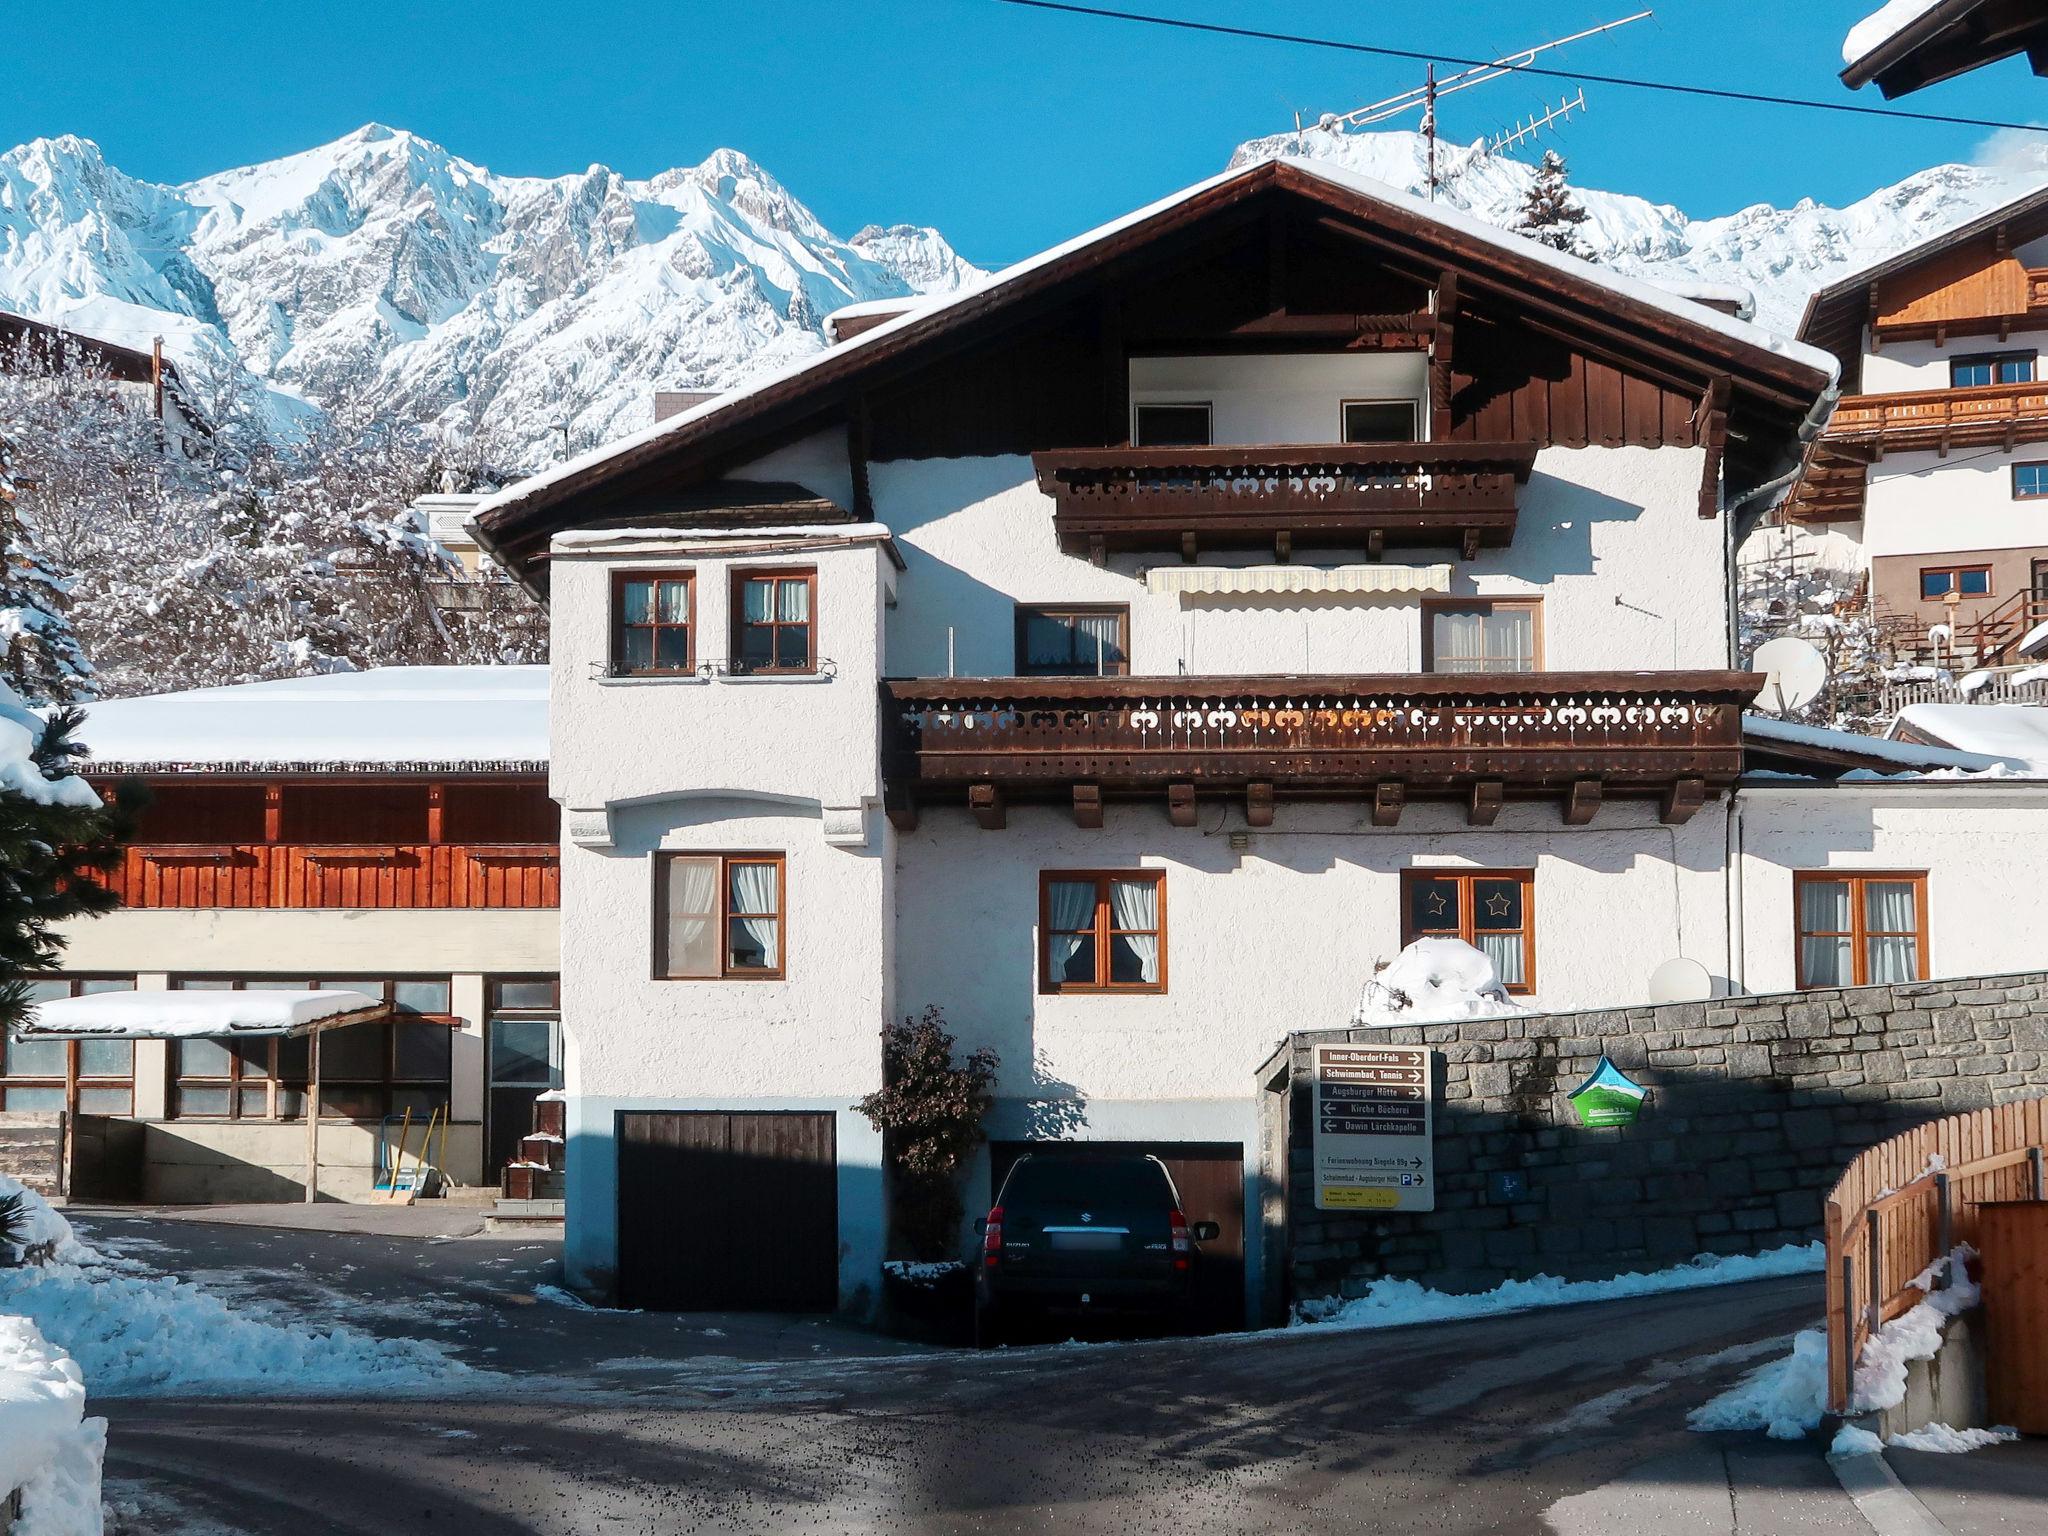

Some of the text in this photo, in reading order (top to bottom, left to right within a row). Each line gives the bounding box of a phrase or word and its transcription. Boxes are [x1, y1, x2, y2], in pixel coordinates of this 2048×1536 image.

[1326, 1069, 1403, 1080] Schwimmbad, Tennis
[1332, 1086, 1398, 1097] Augsburger Hütte
[1351, 1104, 1409, 1114] Kirche Bücherei
[1345, 1121, 1417, 1133] Dawin Lärchkapelle
[1402, 1175, 1410, 1185] P
